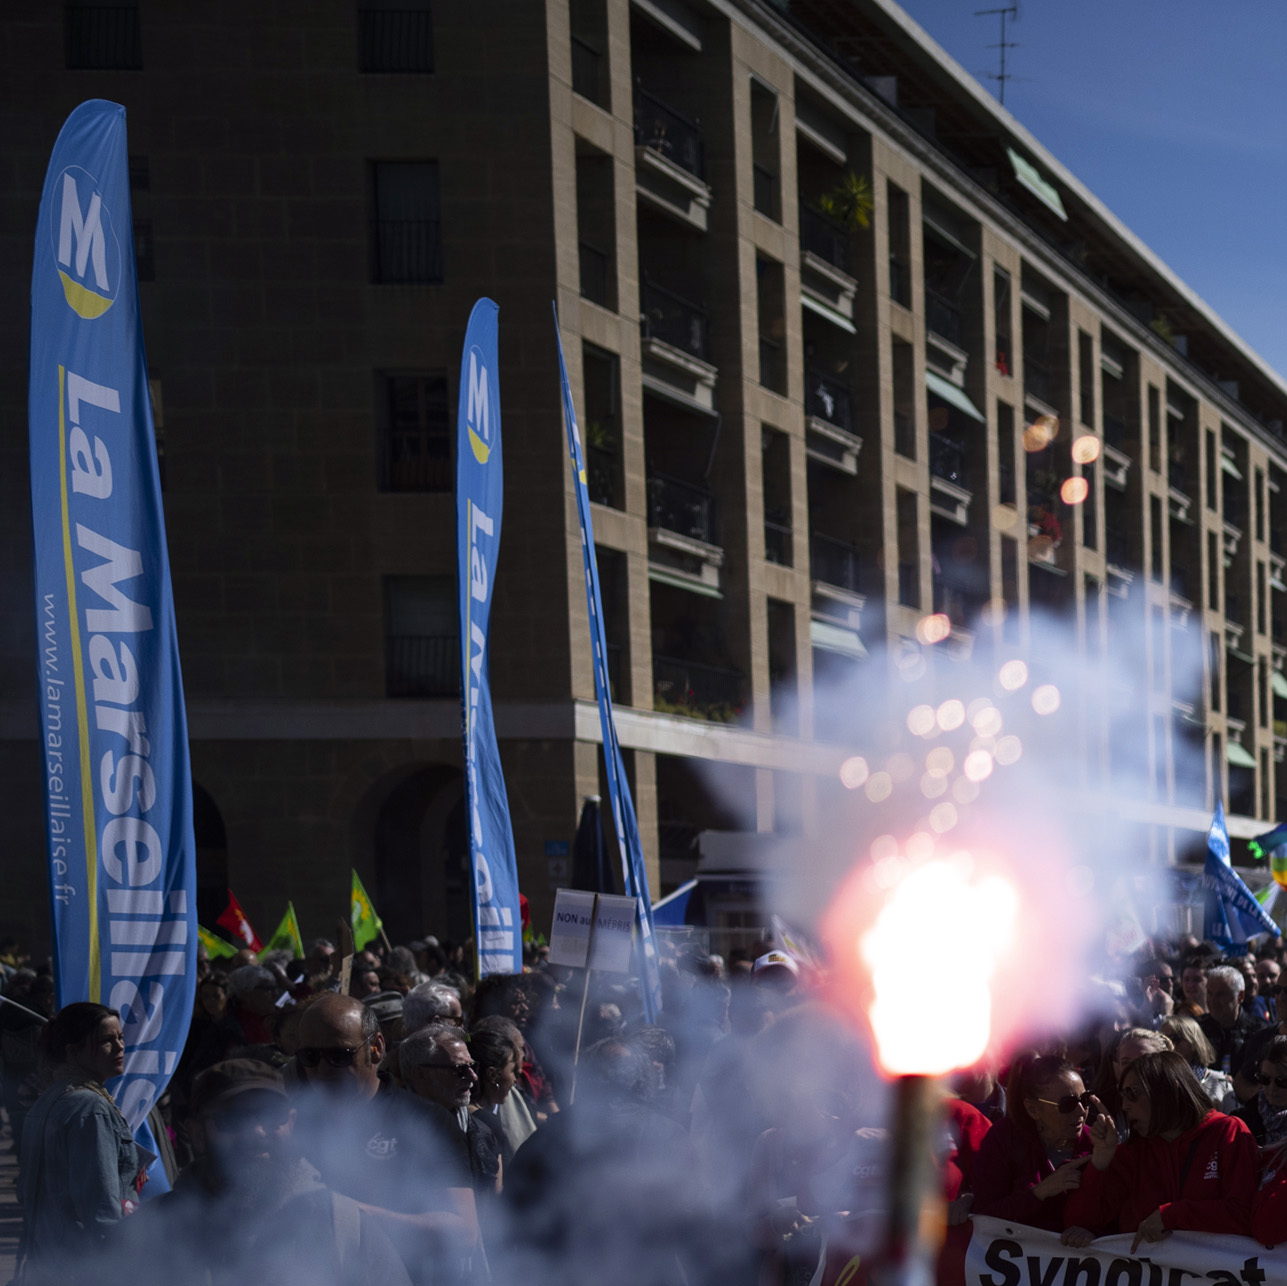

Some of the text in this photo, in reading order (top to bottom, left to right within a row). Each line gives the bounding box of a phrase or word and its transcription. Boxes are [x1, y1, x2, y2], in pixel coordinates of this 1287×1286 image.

[67, 371, 121, 500] La
[43, 592, 76, 906] www.lamarseillaise.fr
[556, 912, 578, 924] NON
[598, 917, 632, 933] MÉPRIS
